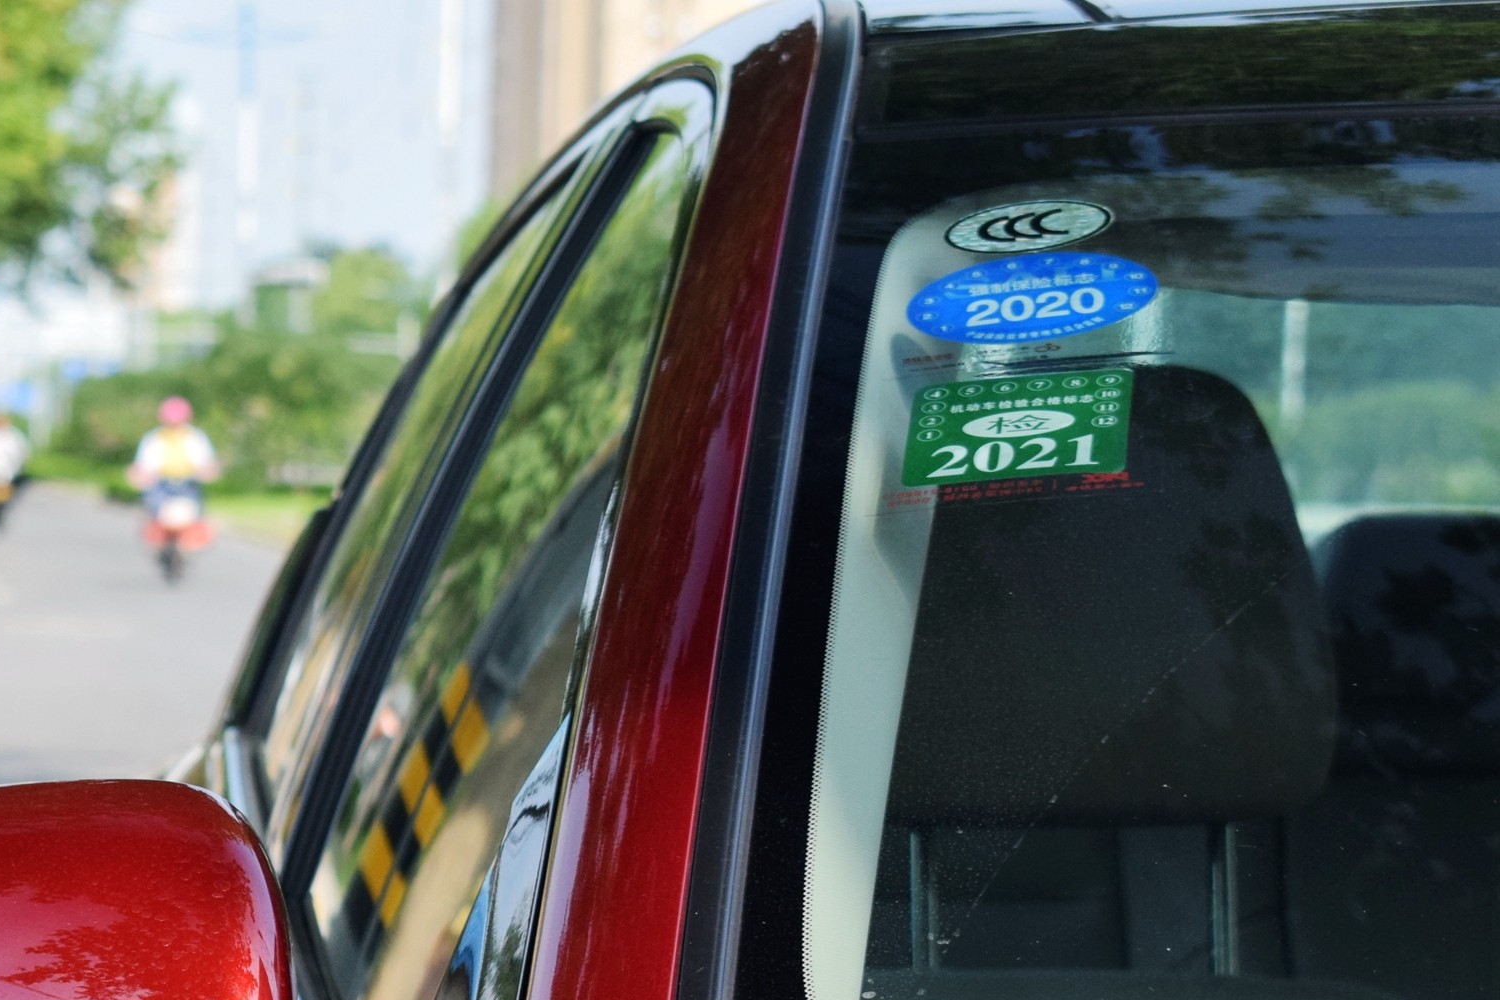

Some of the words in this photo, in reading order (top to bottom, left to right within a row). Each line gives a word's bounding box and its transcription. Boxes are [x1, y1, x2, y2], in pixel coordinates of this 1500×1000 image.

[977, 208, 1070, 242] CCC
[969, 272, 1096, 297] 强制保险标志
[966, 287, 1105, 328] 2020
[949, 393, 1095, 415] 机动车检验合格标志
[1100, 389, 1118, 398] 10
[1099, 403, 1115, 412] 11
[986, 414, 1051, 435] 检
[1097, 416, 1115, 426] 12
[926, 433, 1100, 479] 2021
